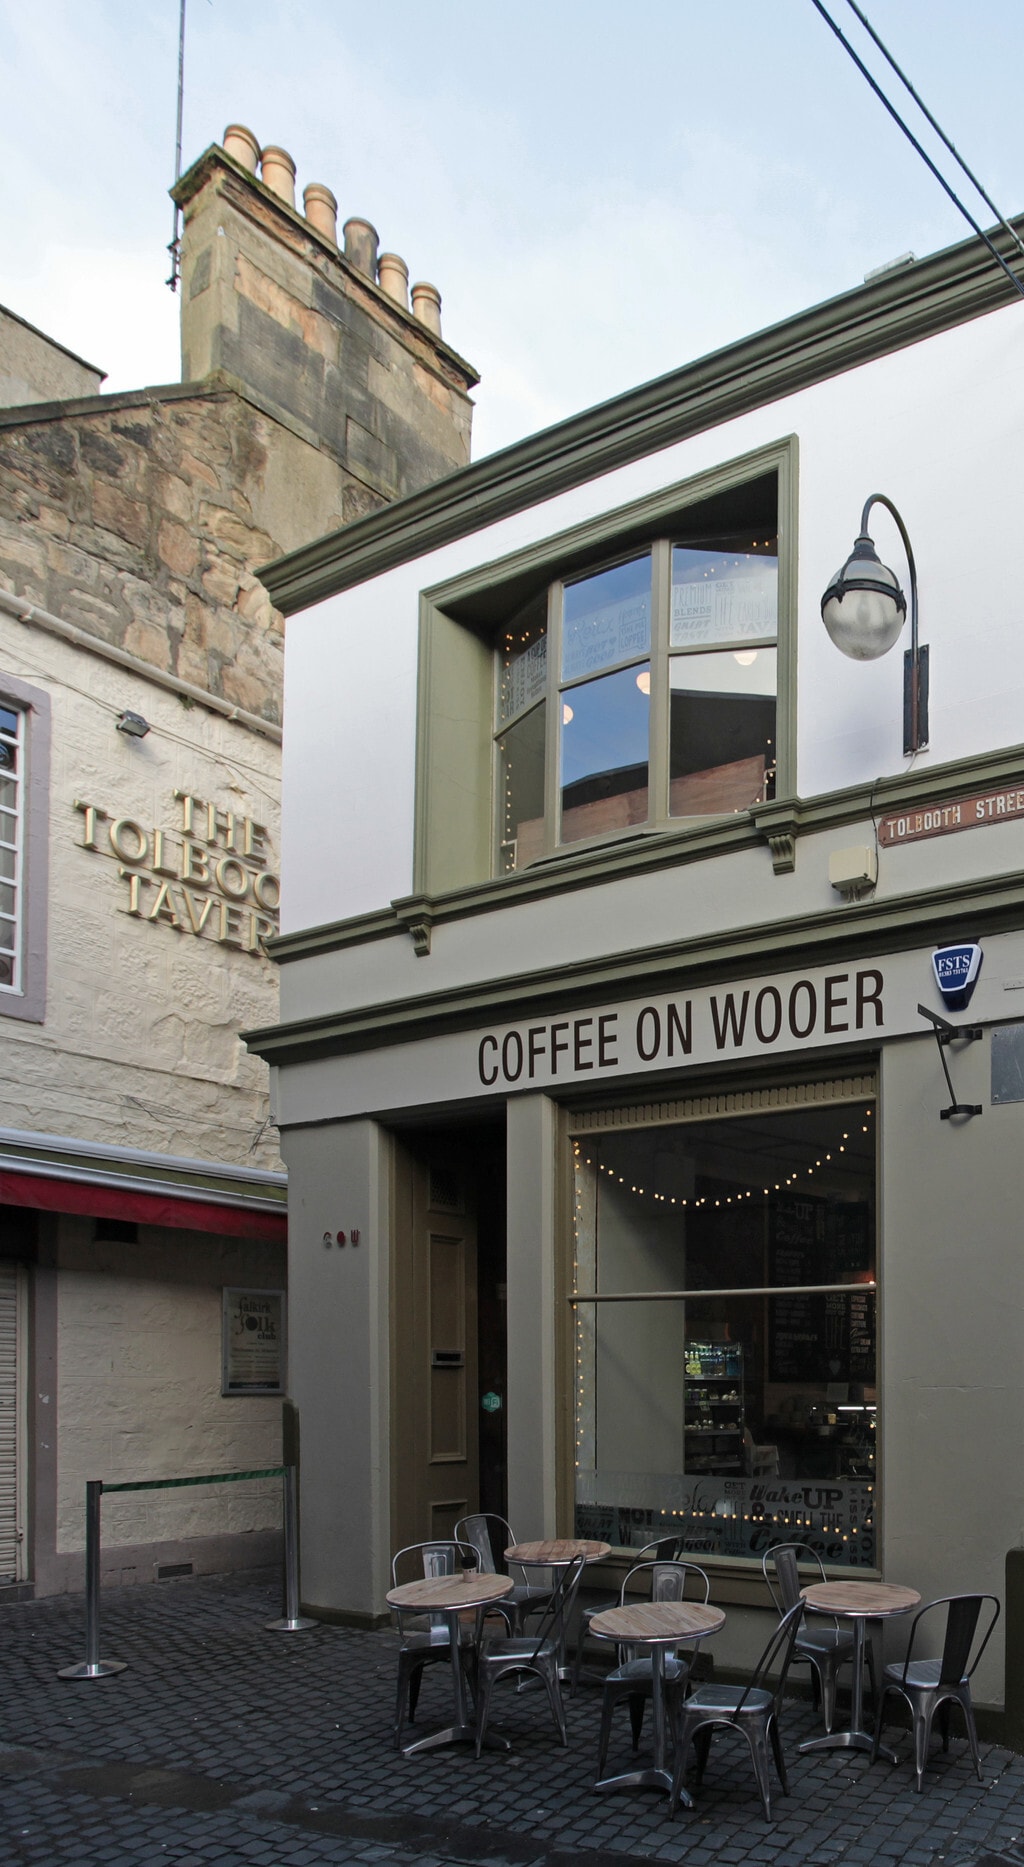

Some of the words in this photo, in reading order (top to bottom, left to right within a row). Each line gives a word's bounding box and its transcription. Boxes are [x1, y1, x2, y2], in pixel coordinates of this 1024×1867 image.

[674, 605, 712, 616] BLENDS
[173, 788, 268, 865] THE
[887, 806, 961, 839] TOLBOOTH
[938, 954, 970, 972] FSTS
[478, 1013, 619, 1086] COFFEE
[636, 1000, 693, 1062] ON
[710, 969, 886, 1051] WOOER
[257, 1331, 277, 1340] club
[724, 1481, 746, 1489] GET
[749, 1484, 803, 1504] Wake
[801, 1486, 844, 1510] UP
[777, 1509, 817, 1532] SMELL
[819, 1511, 844, 1535] THE
